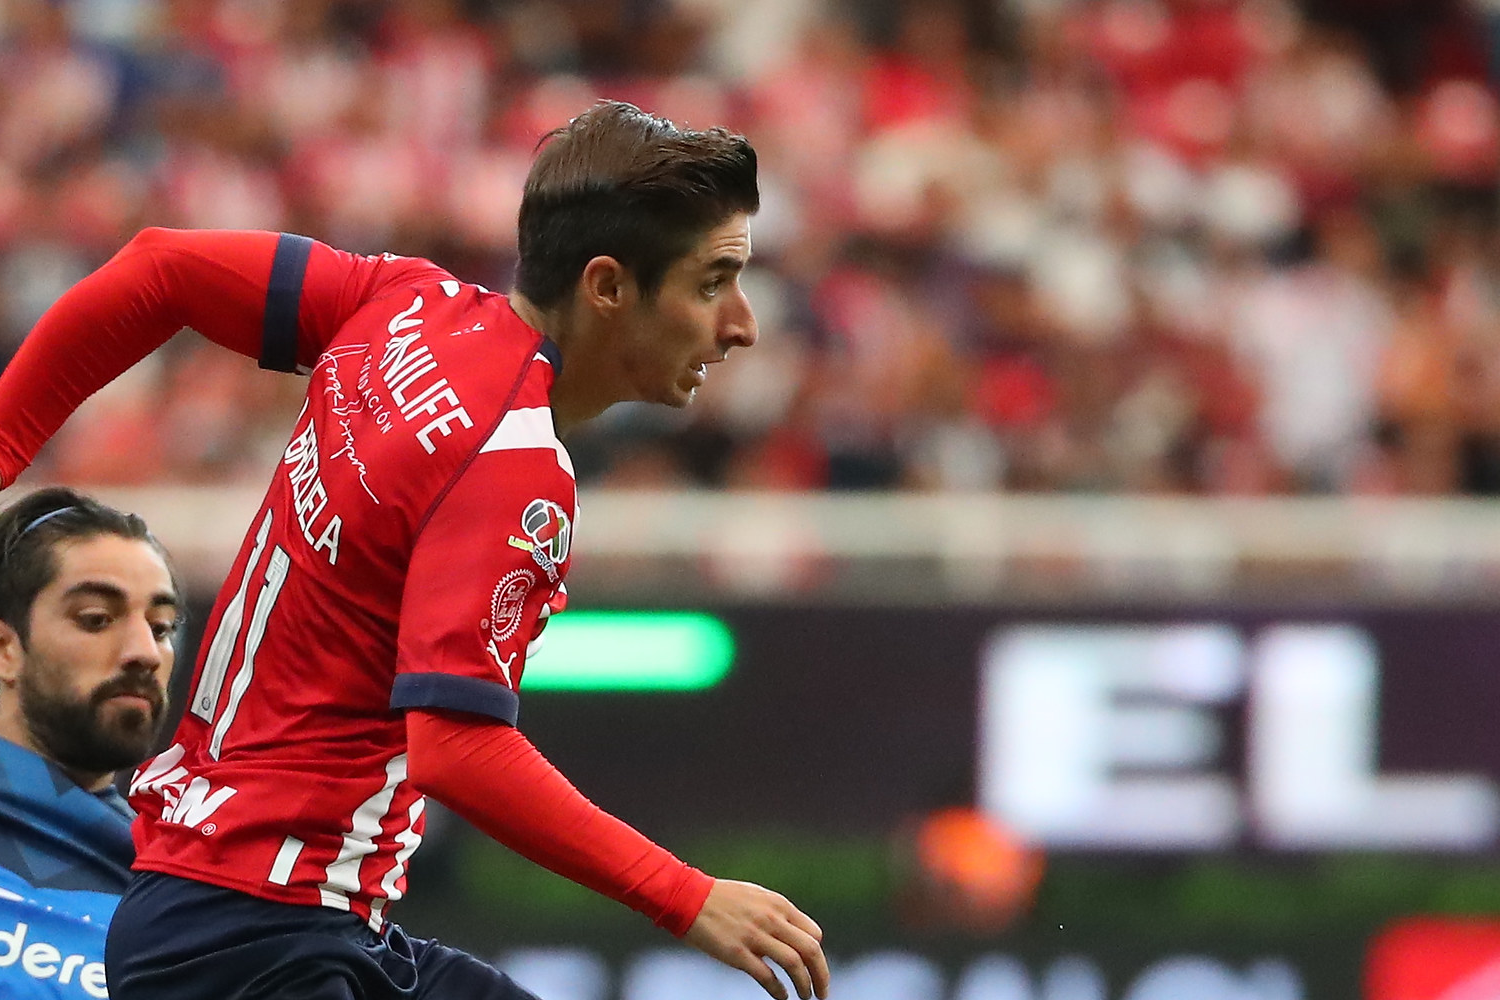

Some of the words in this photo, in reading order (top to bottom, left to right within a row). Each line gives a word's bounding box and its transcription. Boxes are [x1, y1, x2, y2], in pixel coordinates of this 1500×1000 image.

[283, 417, 343, 567] BRIZUELA
[189, 507, 292, 762] 11
[977, 620, 1498, 853] EL
